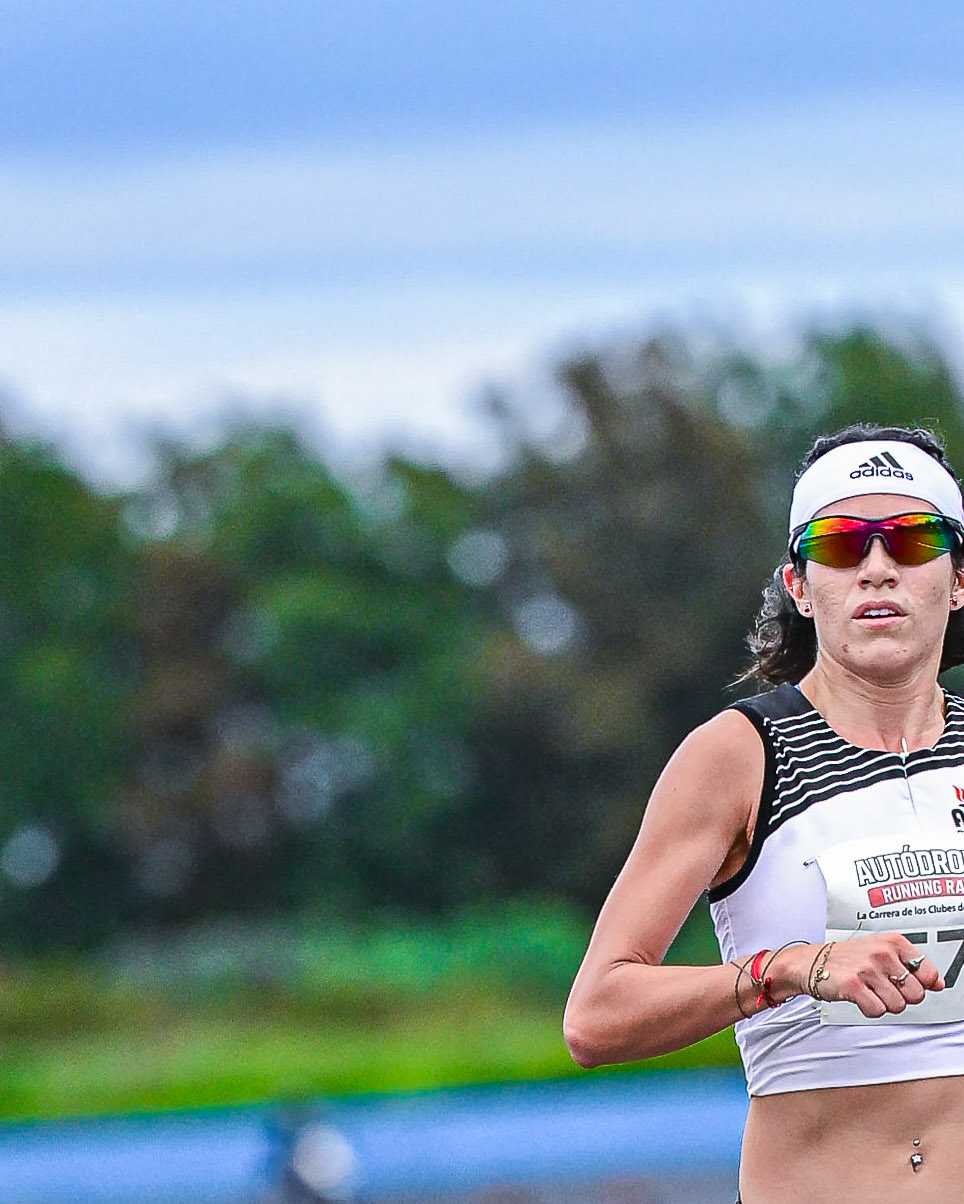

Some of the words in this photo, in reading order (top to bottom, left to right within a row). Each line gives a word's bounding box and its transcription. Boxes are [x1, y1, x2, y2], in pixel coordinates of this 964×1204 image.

[849, 466, 914, 481] adidas
[881, 881, 943, 903] RUNNING
[856, 911, 867, 920] La
[868, 909, 900, 919] Carrera
[901, 907, 913, 916] de
[914, 905, 927, 915] los
[928, 902, 957, 913] Clubes
